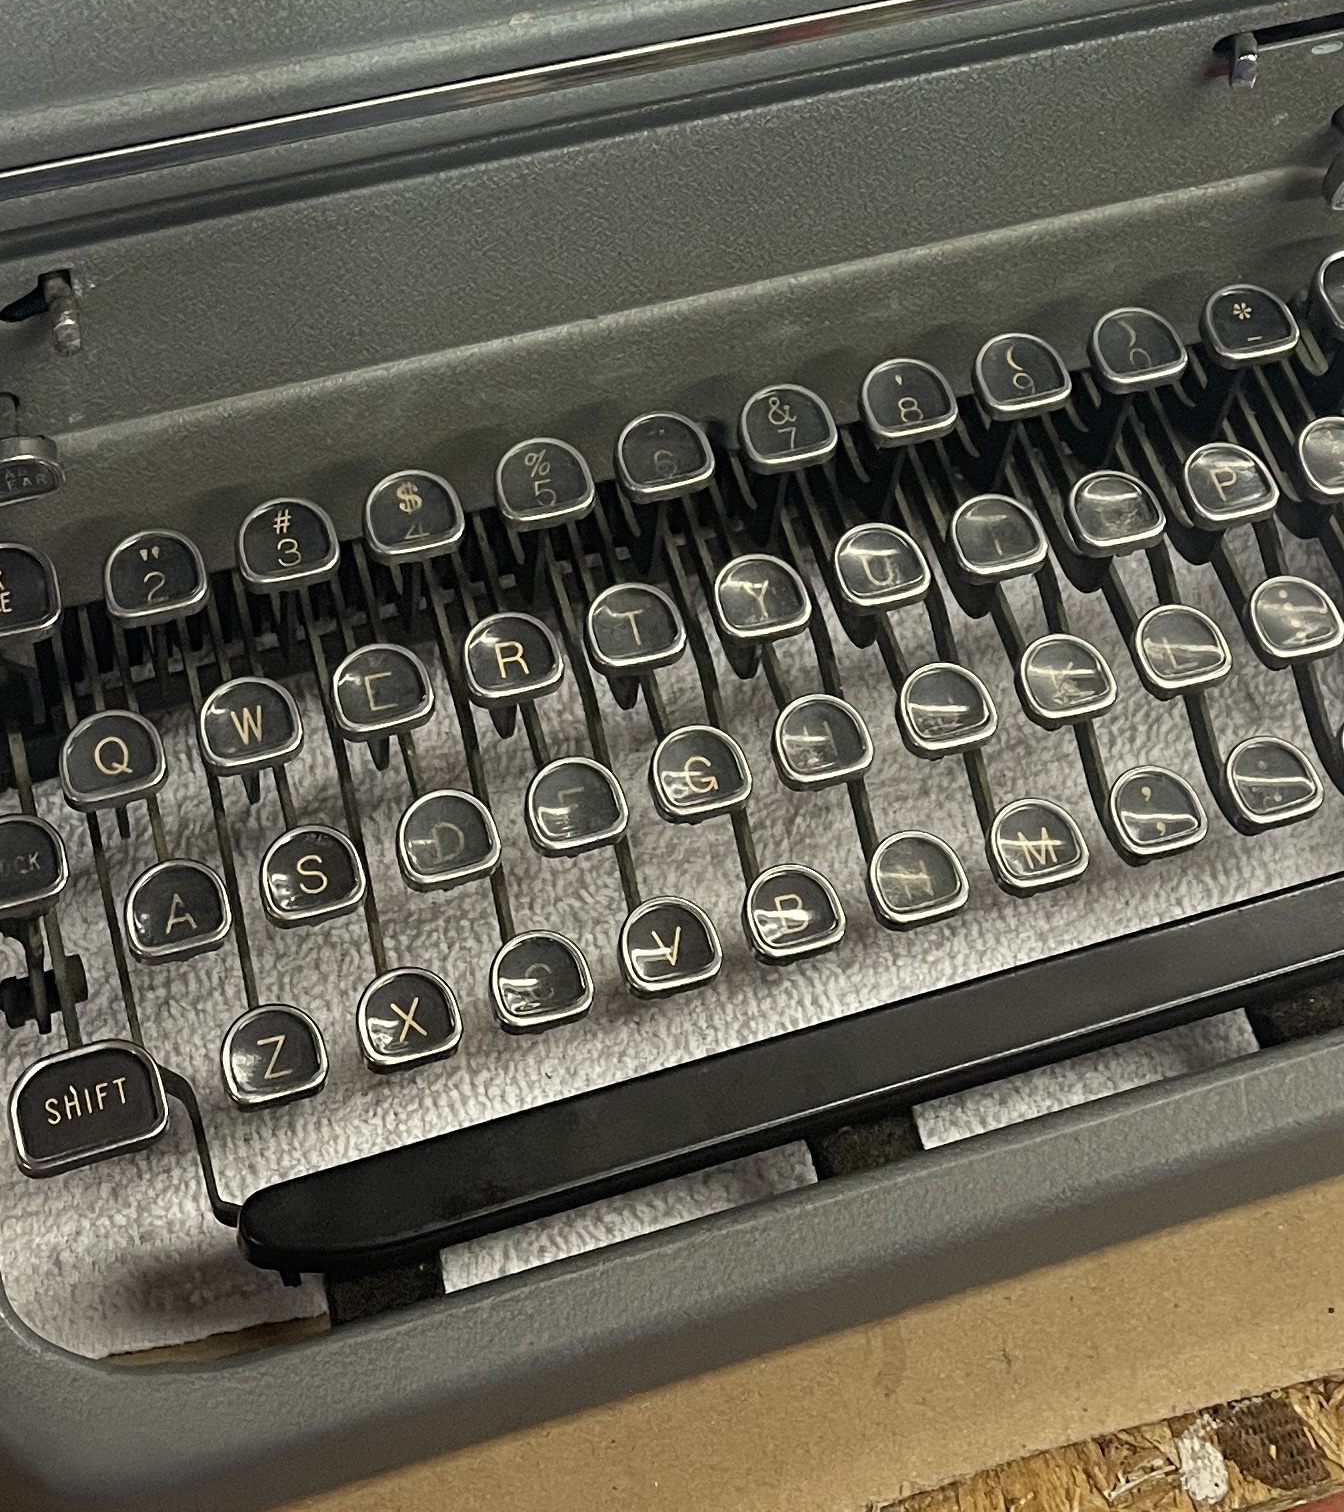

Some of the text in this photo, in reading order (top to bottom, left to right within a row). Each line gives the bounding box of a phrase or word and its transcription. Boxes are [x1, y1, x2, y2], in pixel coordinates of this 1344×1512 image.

[1013, 372, 1036, 395] 9
[768, 396, 797, 426] &
[897, 397, 923, 424] 8
[777, 427, 797, 450] 7
[525, 448, 550, 478] %
[396, 481, 422, 516] $
[534, 478, 556, 508] 5
[1209, 465, 1238, 502] P
[272, 508, 292, 535] #
[403, 521, 429, 541] 4
[276, 538, 302, 568] 3
[861, 554, 892, 587] U
[143, 571, 170, 603] 2
[743, 579, 770, 620] Y
[619, 609, 644, 647] T
[494, 640, 530, 679] R
[1162, 637, 1198, 670] L
[364, 671, 398, 712] E
[230, 704, 263, 745] W
[94, 736, 133, 775] Q
[682, 755, 718, 794] G
[432, 821, 465, 863] D
[1017, 826, 1058, 870] M
[296, 854, 329, 895] S
[165, 893, 198, 935] A
[774, 893, 811, 934] B
[651, 925, 682, 966] V
[390, 996, 428, 1043] X
[256, 1033, 294, 1081] Z
[43, 1076, 129, 1126] SHIFT
